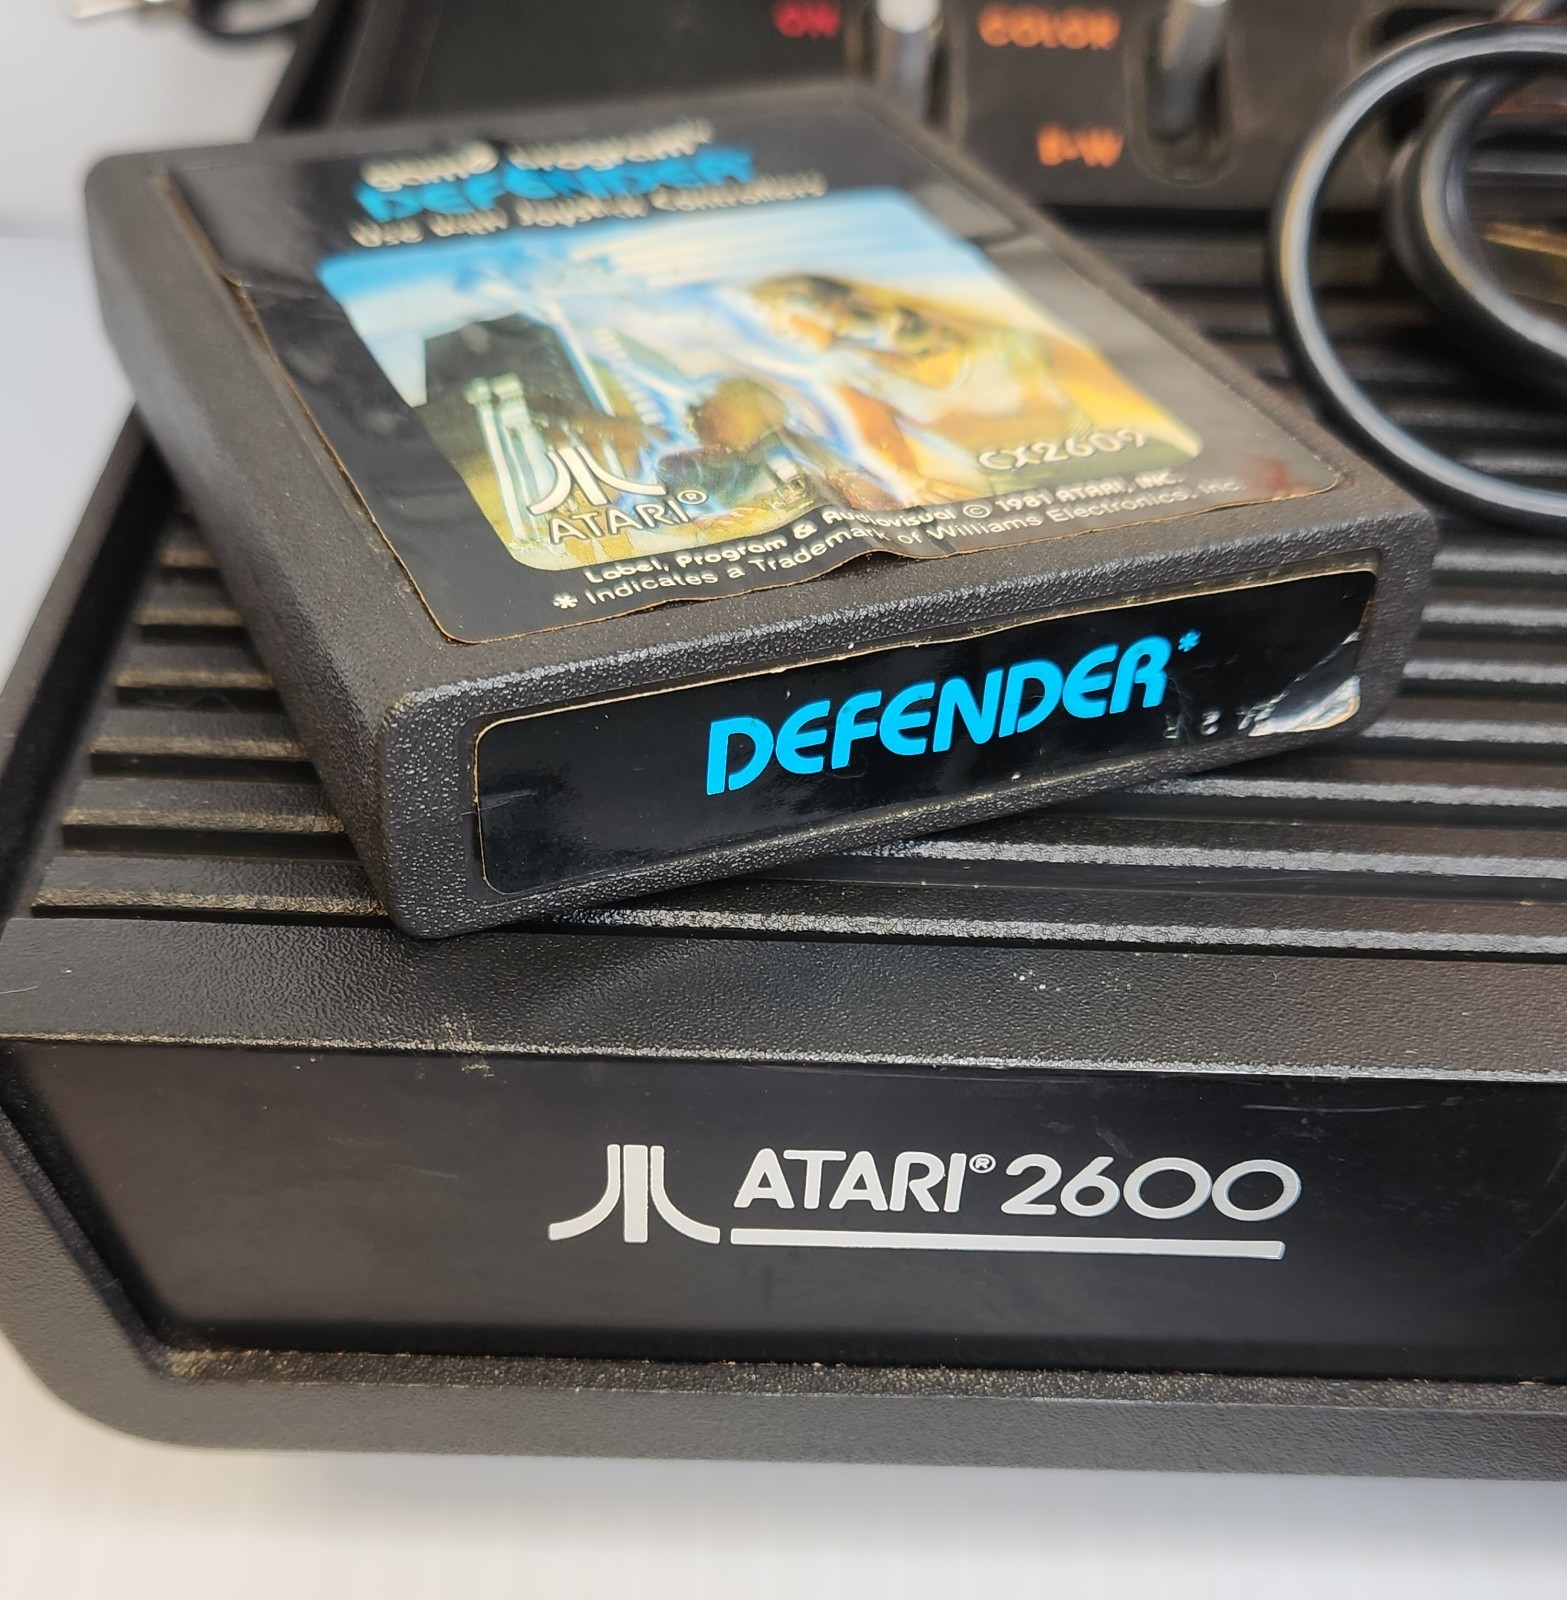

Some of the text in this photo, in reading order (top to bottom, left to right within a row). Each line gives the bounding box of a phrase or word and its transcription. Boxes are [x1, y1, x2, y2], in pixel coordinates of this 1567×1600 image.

[978, 4, 1120, 50] COLOR
[978, 428, 1148, 472] CX2609
[584, 556, 671, 584] Label,
[677, 532, 788, 569] Program
[792, 517, 818, 541] &
[821, 506, 957, 529] Audiovisual
[995, 491, 1053, 511] 1981
[585, 568, 719, 605] Indicates
[727, 564, 746, 580] a
[747, 522, 889, 573] Trademark
[896, 532, 923, 546] of
[927, 512, 1043, 541] Williams
[1000, 1153, 1302, 1222] 2600
